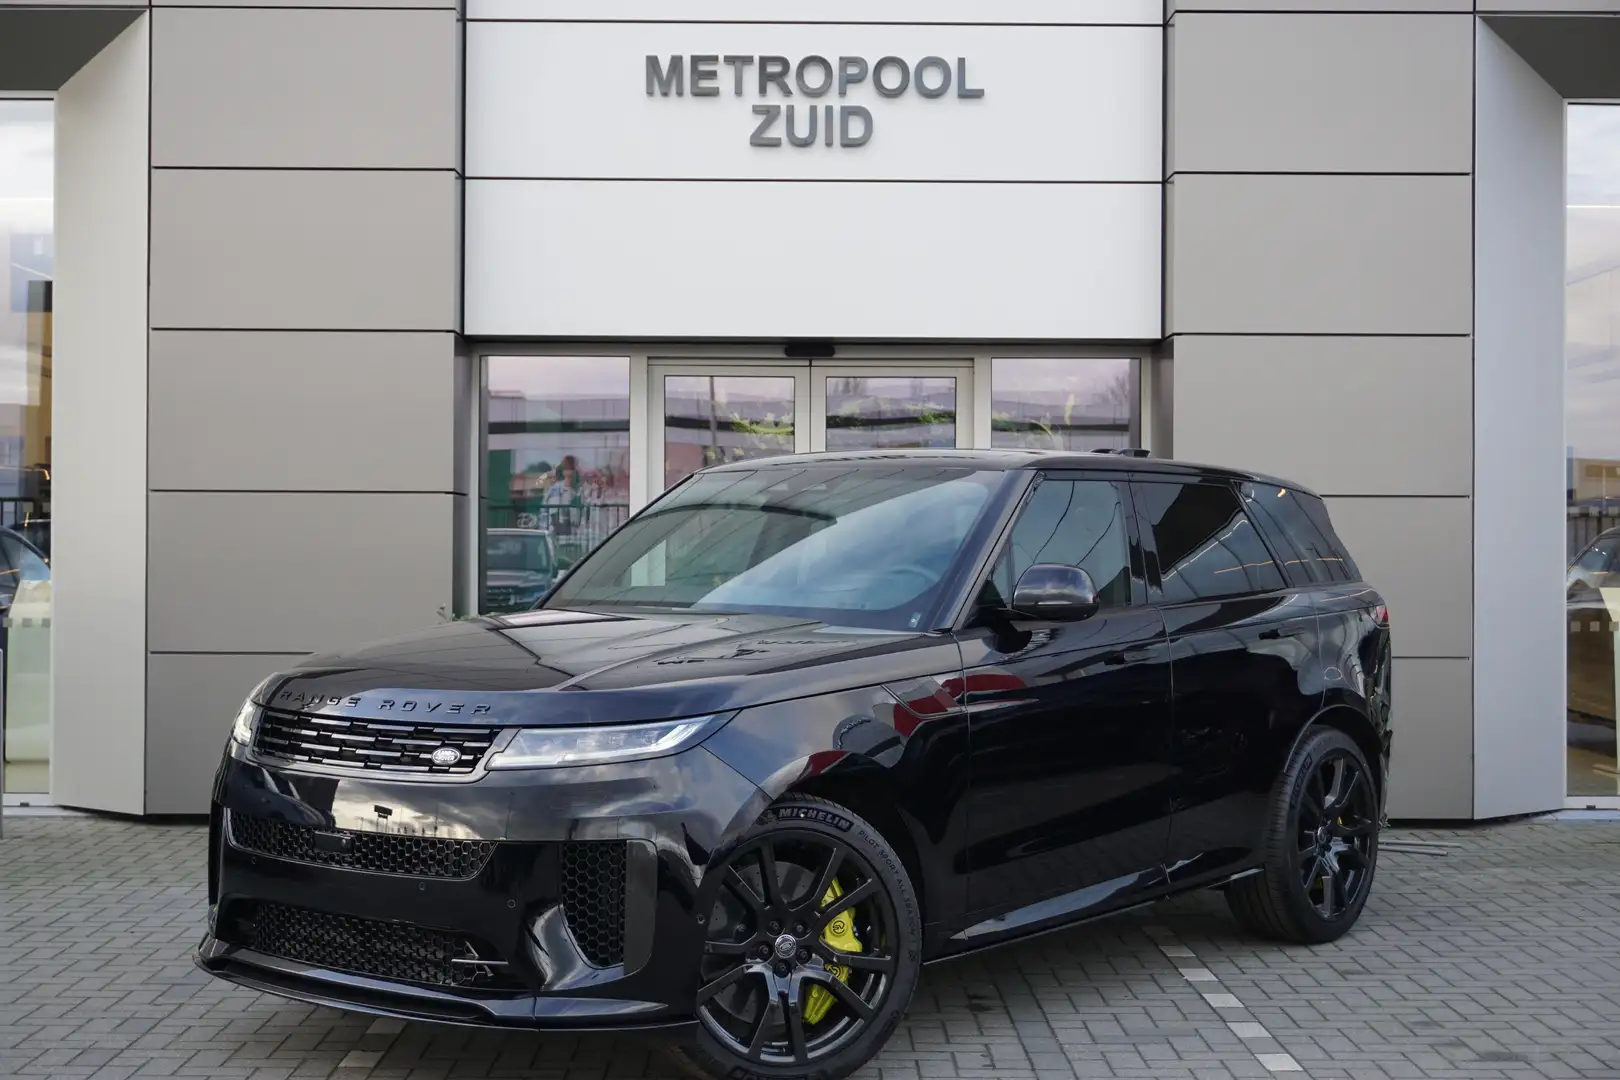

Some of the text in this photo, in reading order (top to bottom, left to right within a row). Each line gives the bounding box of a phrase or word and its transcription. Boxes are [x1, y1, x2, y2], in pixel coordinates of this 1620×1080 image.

[645, 54, 985, 99] METROPOOL
[749, 104, 873, 148] ZUID
[279, 691, 491, 716] RANGE ROVER
[779, 807, 851, 830] MICHELIN
[858, 830, 880, 850] PILOT
